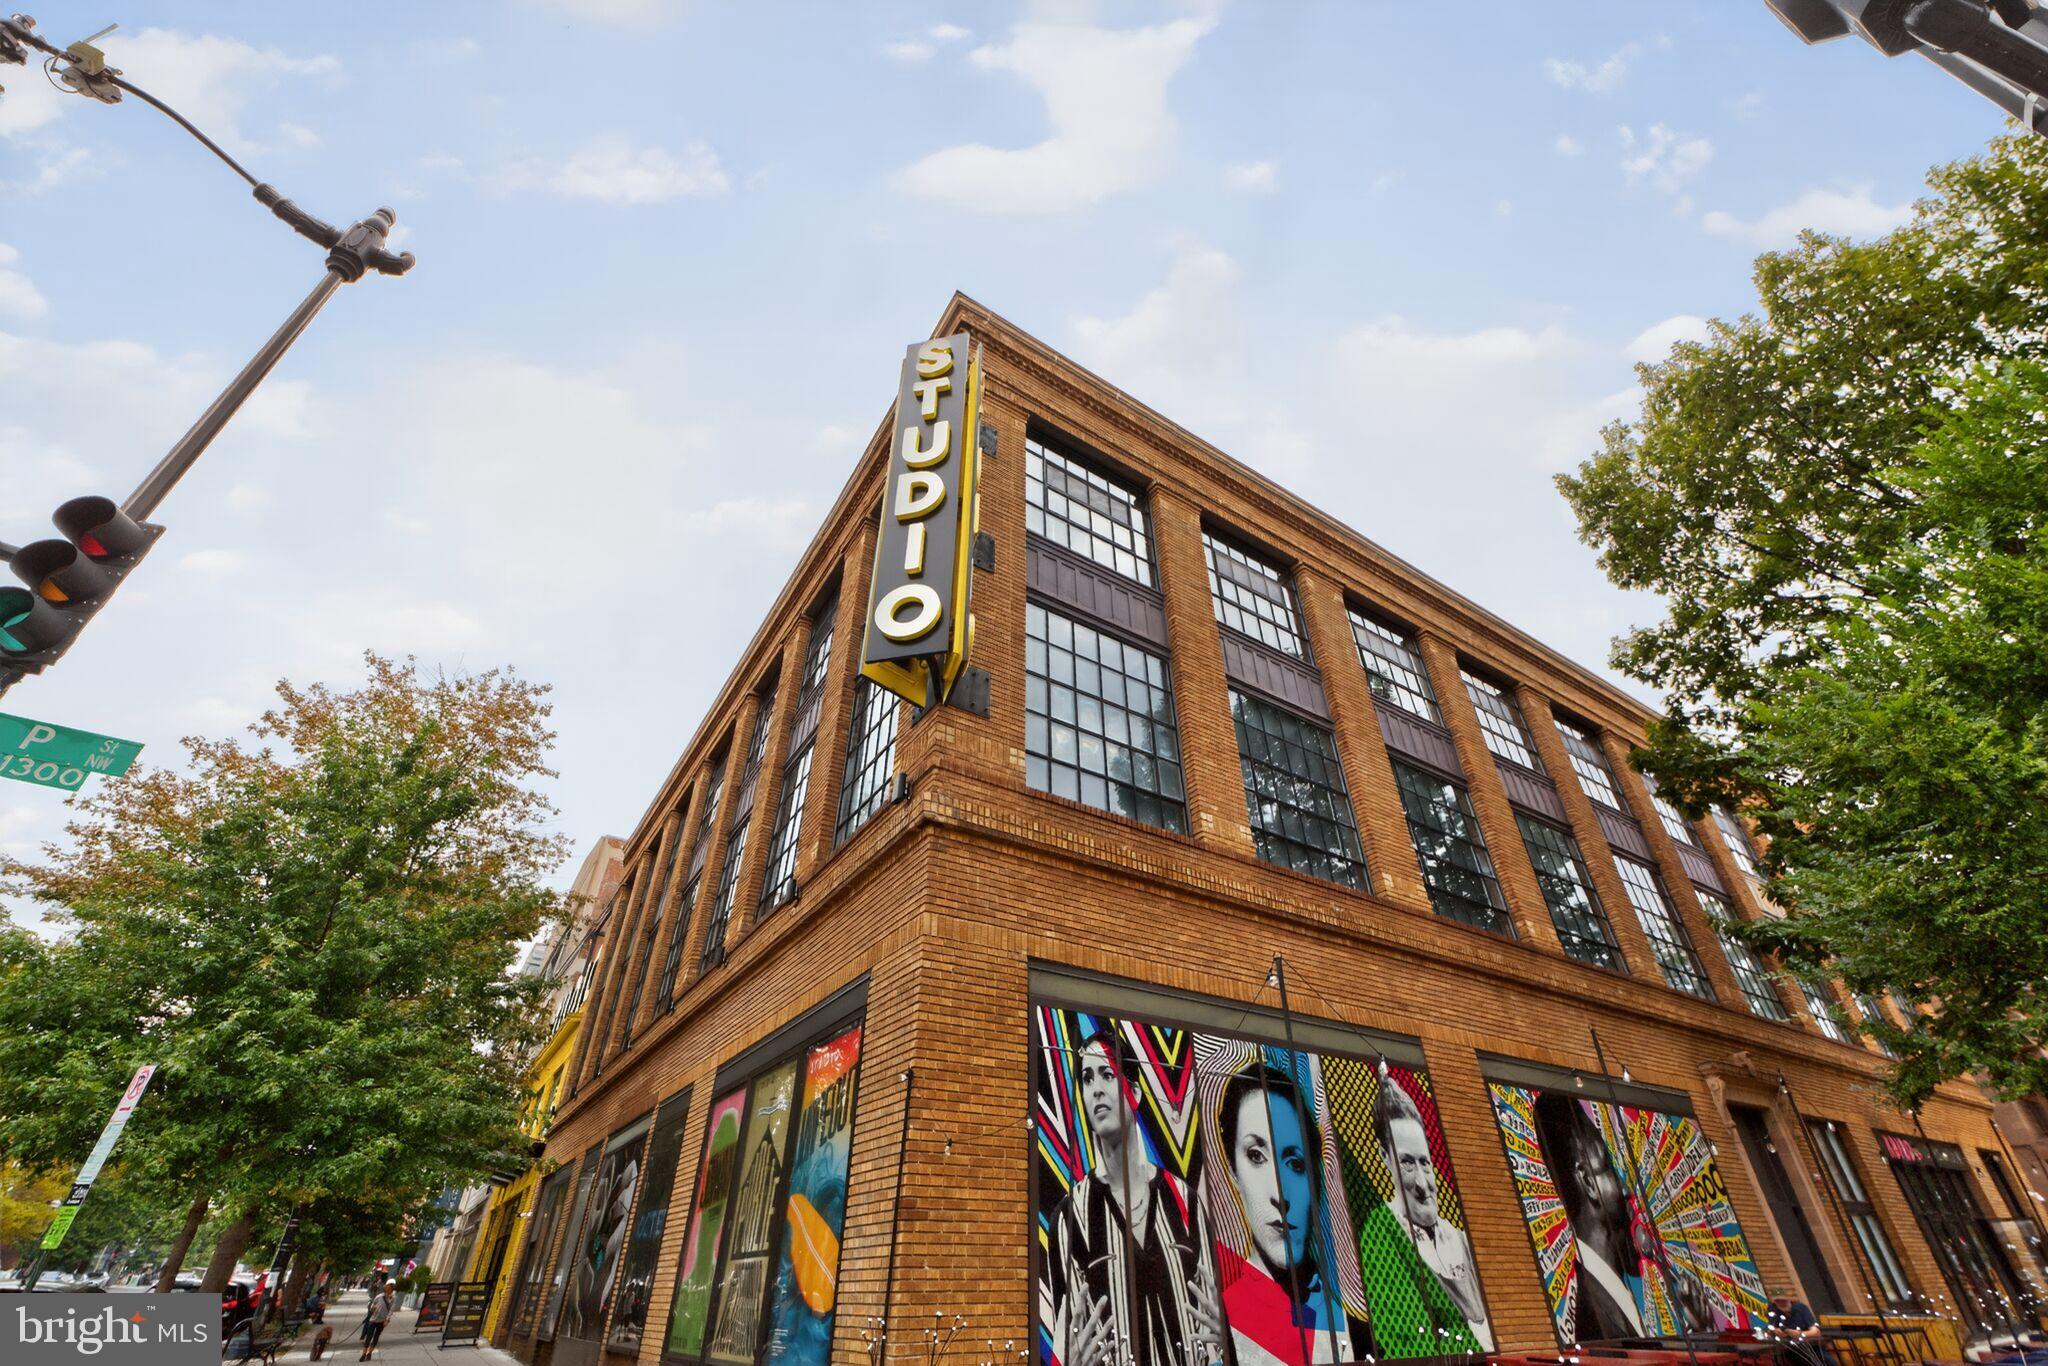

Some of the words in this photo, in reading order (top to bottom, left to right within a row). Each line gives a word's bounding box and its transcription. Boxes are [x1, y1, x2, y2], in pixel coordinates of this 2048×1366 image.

[874, 338, 955, 641] STUDIO
[18, 724, 56, 750] P
[0, 754, 84, 786] 1300
[83, 753, 114, 771] NW
